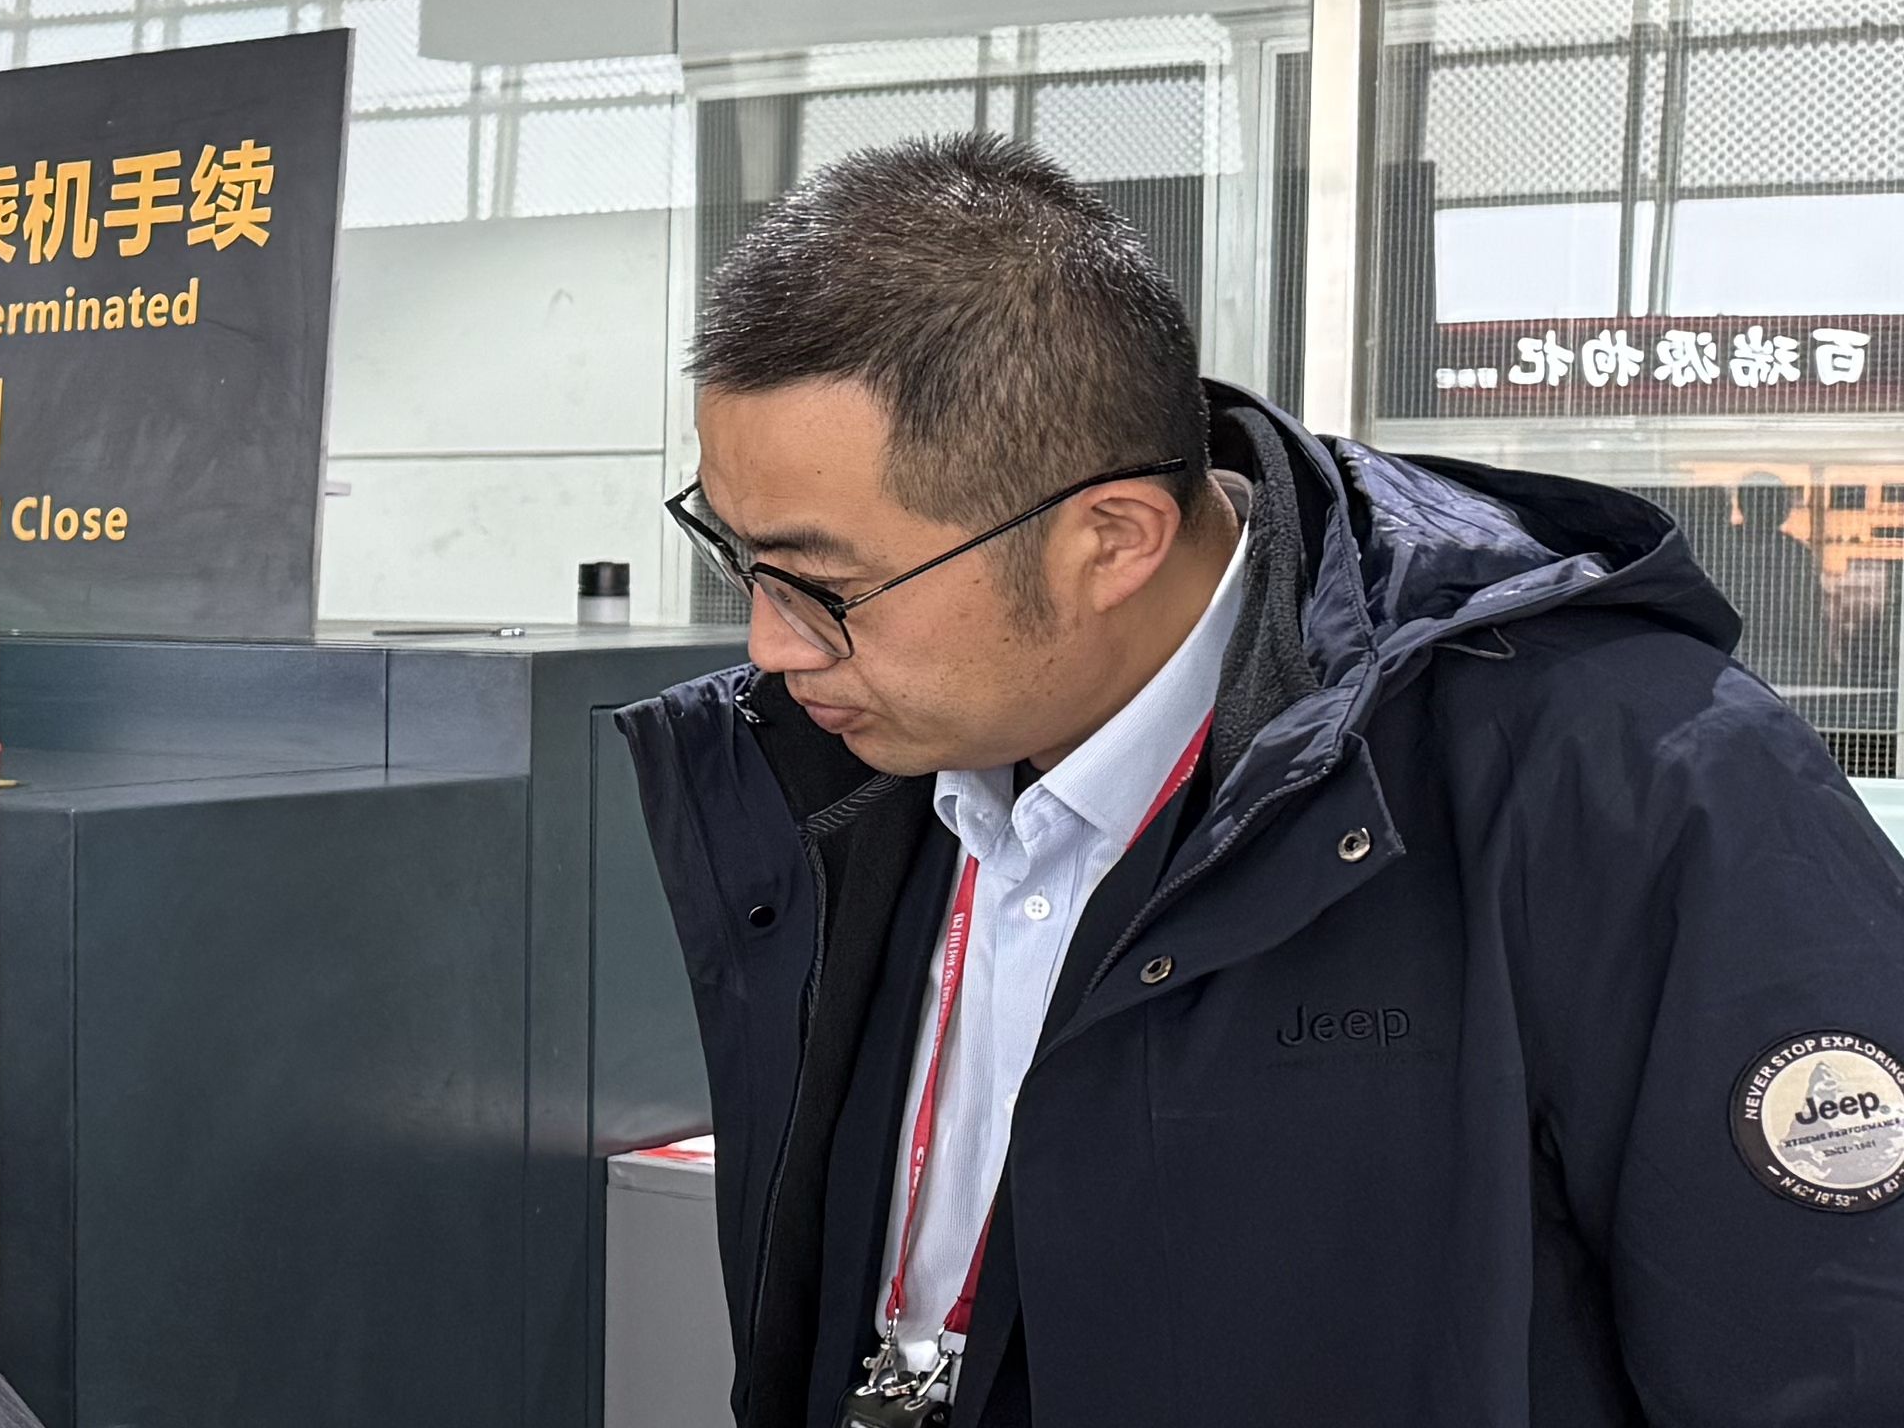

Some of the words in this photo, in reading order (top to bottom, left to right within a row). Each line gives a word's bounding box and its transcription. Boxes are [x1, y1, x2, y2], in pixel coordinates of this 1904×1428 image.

[11, 495, 128, 541] Close
[1277, 1004, 1410, 1048] Jeep
[1745, 1066, 1775, 1119] NEVER
[1771, 1039, 1816, 1067] STOP
[1795, 1091, 1880, 1125] Jeep
